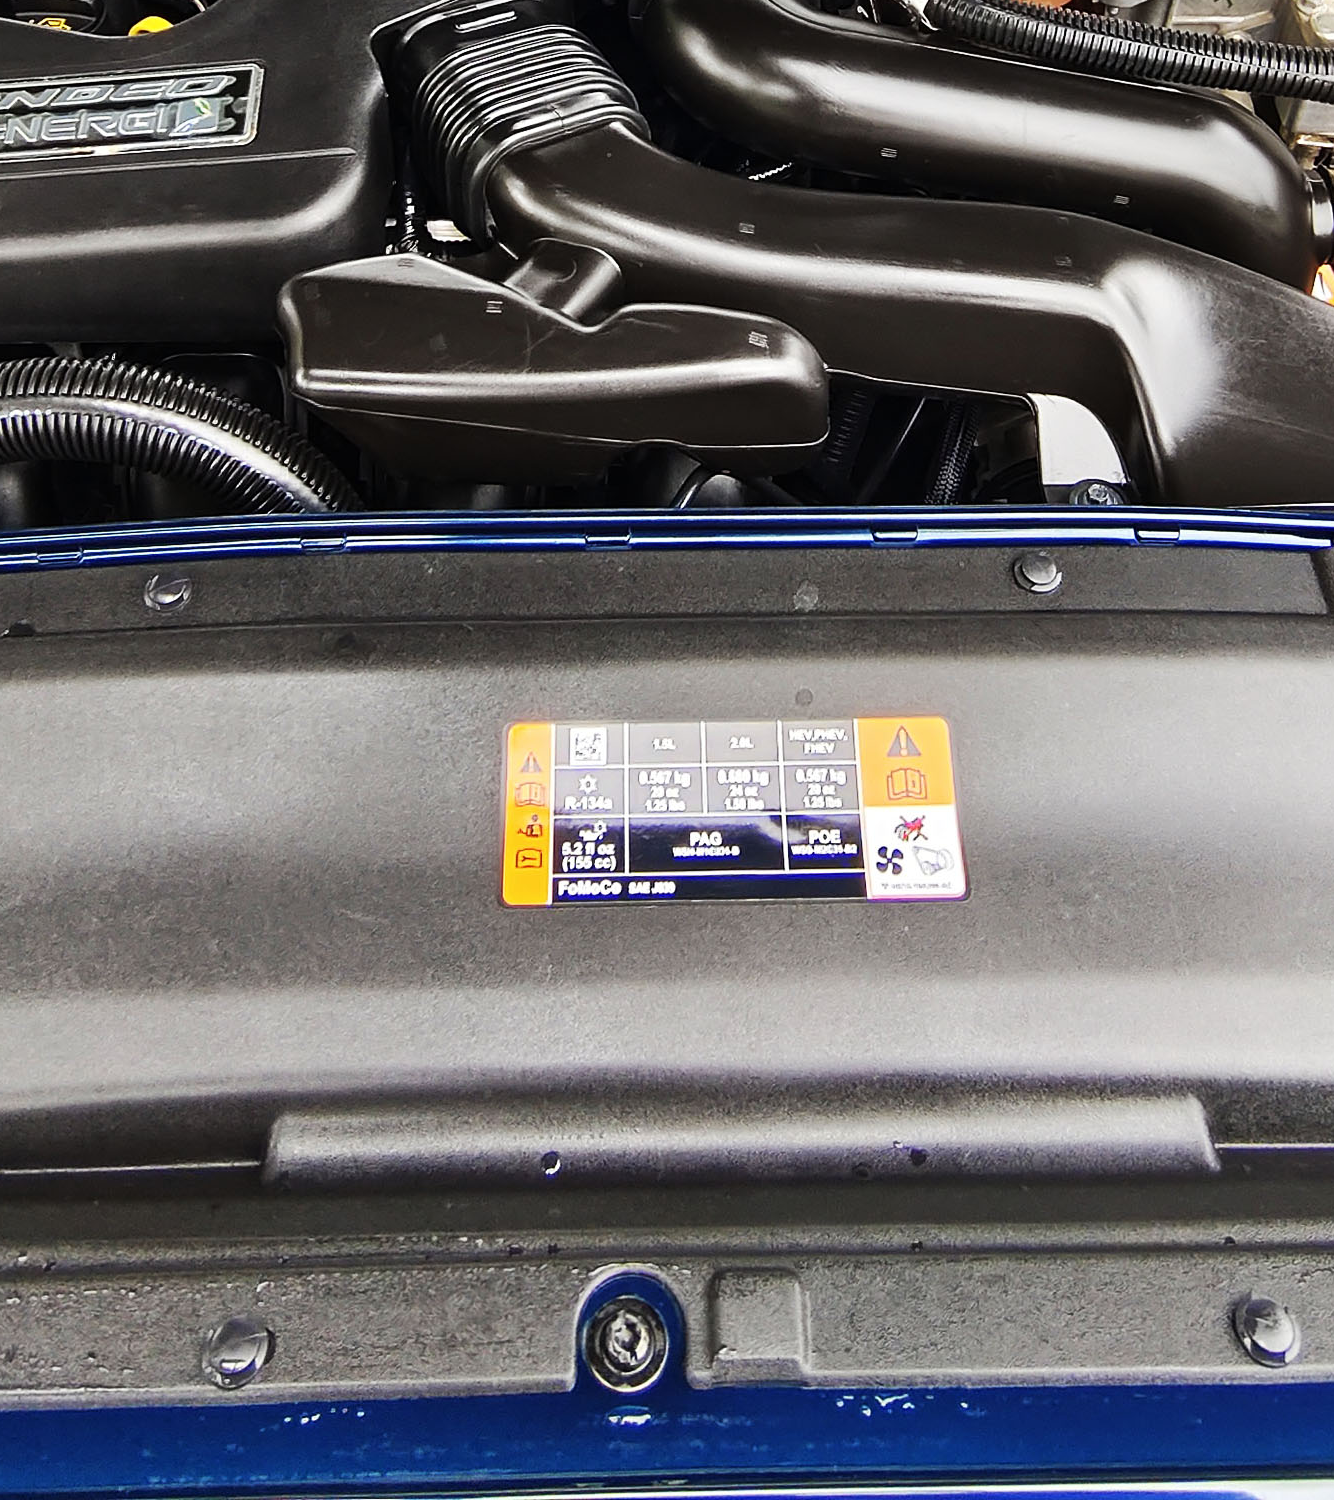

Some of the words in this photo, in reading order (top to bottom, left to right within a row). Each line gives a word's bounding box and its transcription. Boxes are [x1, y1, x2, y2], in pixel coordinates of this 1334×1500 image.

[673, 770, 691, 788] kg
[752, 769, 770, 788] kg
[830, 769, 847, 787] kg
[564, 795, 613, 810] R-134a
[689, 831, 722, 847] PAG
[808, 829, 842, 846] POE
[561, 843, 583, 856] 5.2
[558, 879, 622, 896] FoMoCo
[628, 881, 650, 895] SAE
